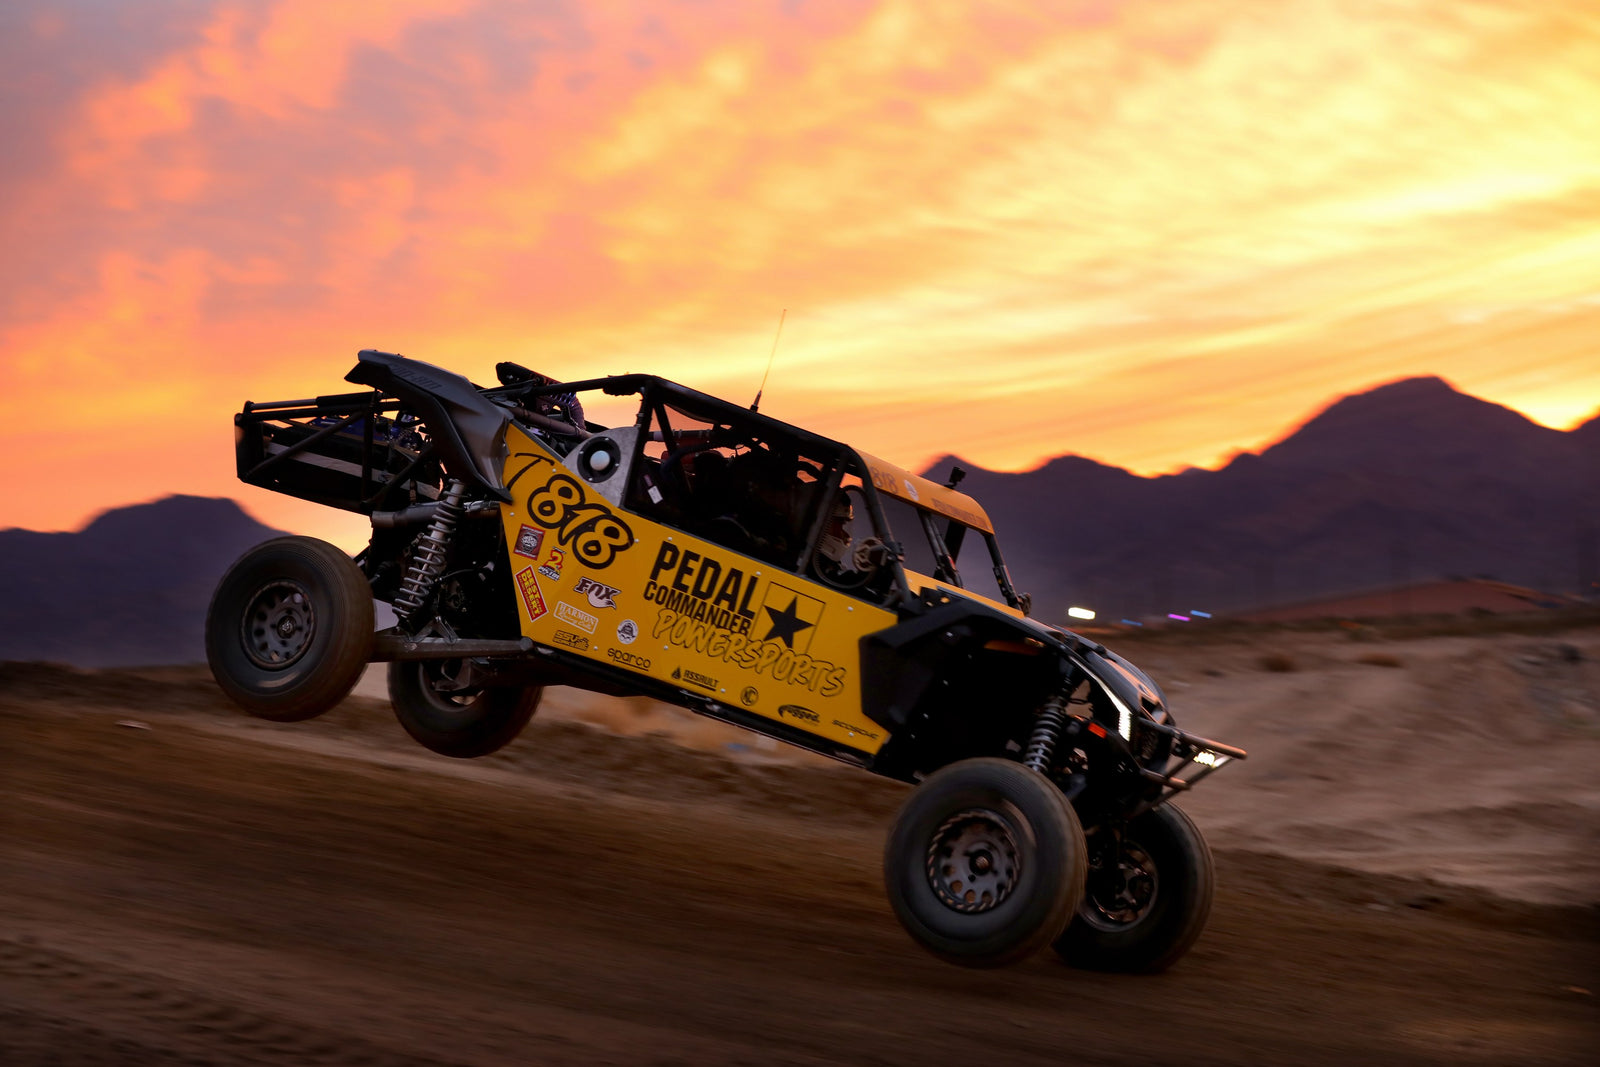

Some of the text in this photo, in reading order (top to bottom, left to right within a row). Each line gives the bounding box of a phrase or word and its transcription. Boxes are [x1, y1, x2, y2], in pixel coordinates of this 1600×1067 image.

[577, 579, 617, 601] FOX
[650, 540, 759, 620] PEDAL
[560, 605, 595, 625] HARMON
[643, 581, 752, 637] COMMANDER
[607, 648, 651, 669] sparco
[653, 608, 847, 697] POWERSPORTS
[684, 669, 719, 688] ASSAULT
